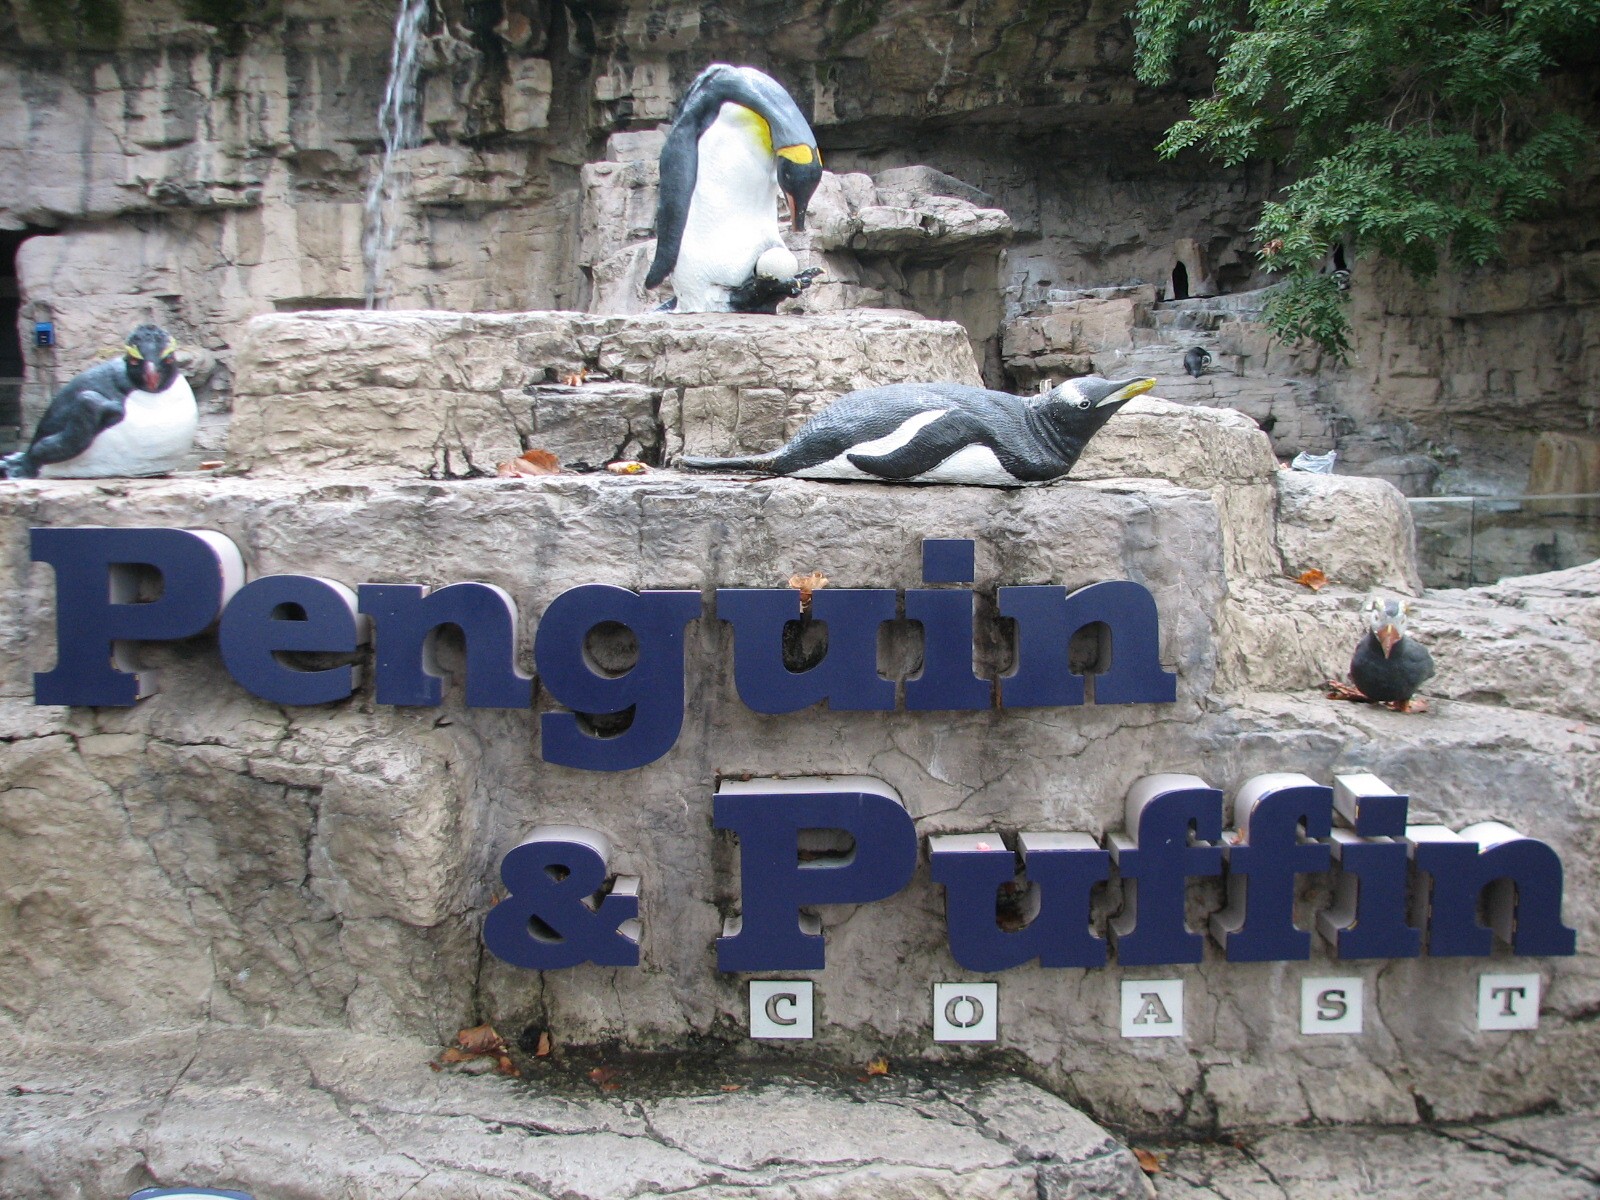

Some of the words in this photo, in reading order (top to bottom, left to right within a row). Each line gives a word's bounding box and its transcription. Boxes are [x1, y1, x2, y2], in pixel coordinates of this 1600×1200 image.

[30, 527, 1176, 771] Penguin
[484, 841, 639, 969] &
[713, 786, 1575, 972] Puffin
[764, 986, 1526, 1029] COAST
